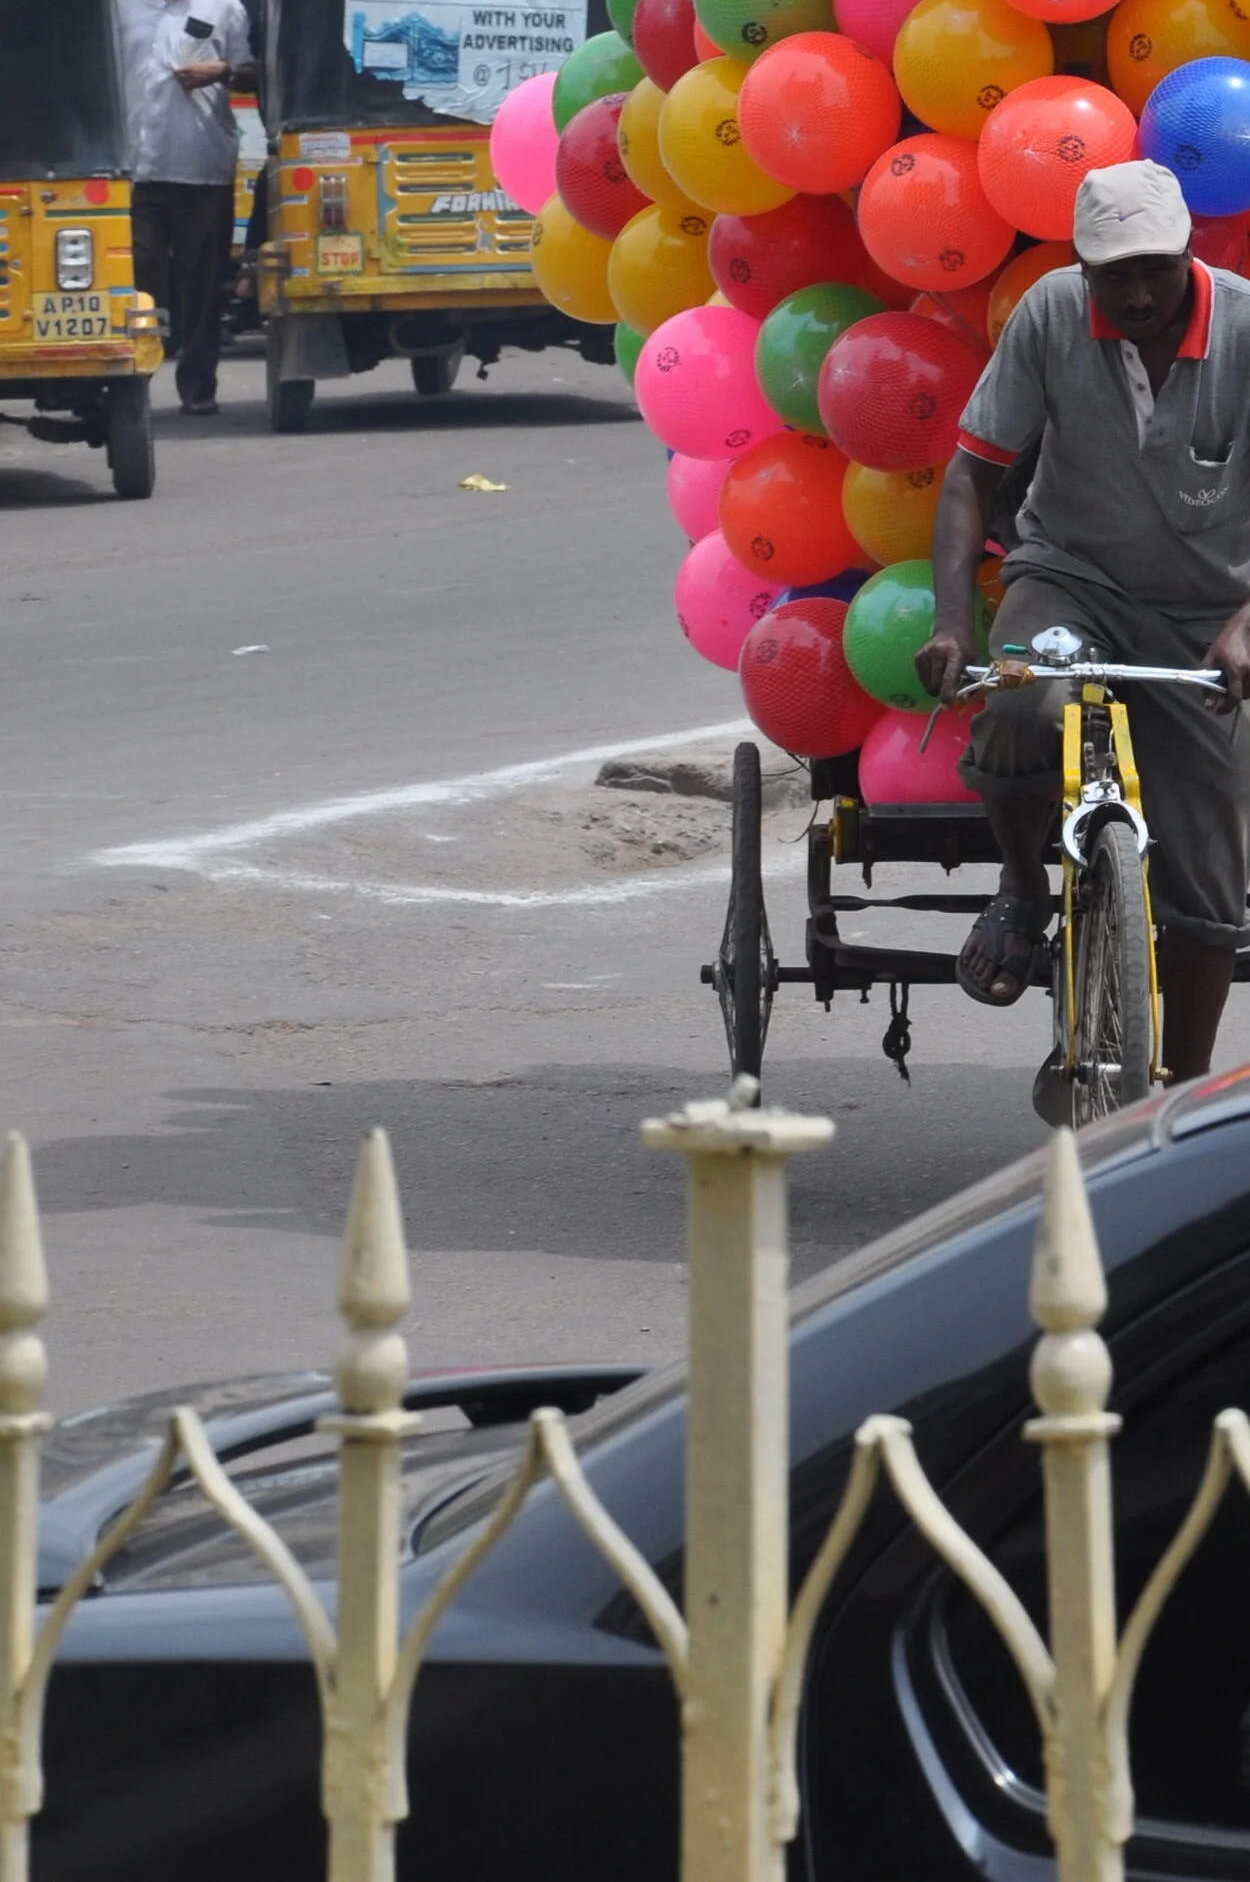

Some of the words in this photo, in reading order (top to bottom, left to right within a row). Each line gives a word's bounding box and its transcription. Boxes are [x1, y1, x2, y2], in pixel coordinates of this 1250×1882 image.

[472, 9, 516, 29] WITH
[521, 10, 566, 30] YOUR
[463, 34, 575, 54] ADVERTISING
[321, 251, 359, 266] STOP
[36, 317, 108, 338] V1207
